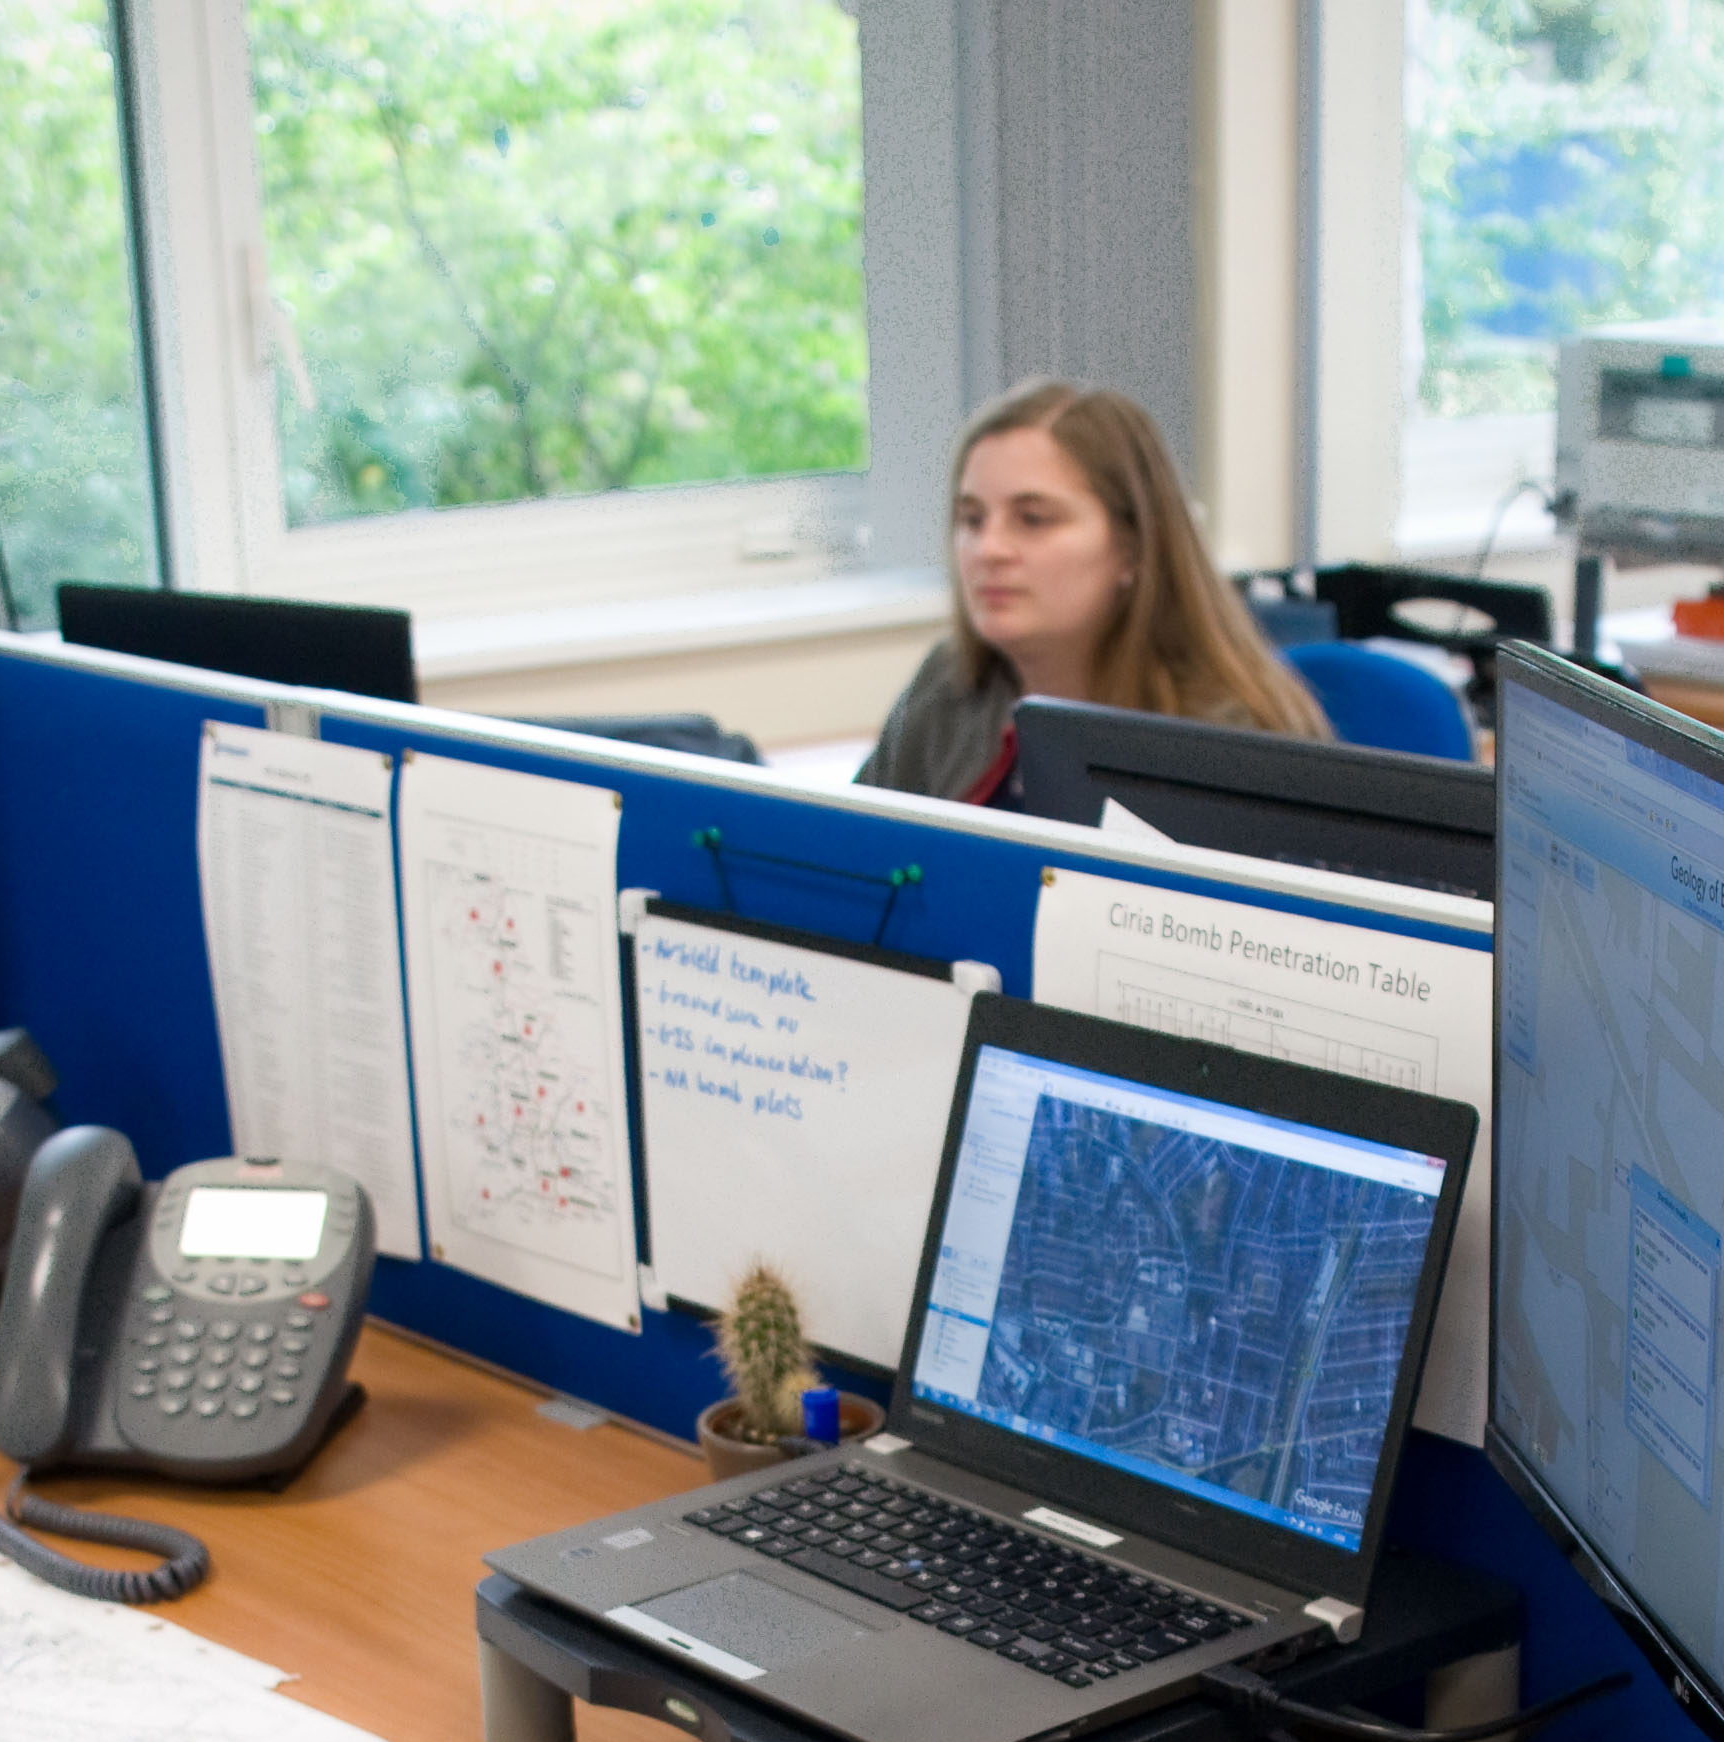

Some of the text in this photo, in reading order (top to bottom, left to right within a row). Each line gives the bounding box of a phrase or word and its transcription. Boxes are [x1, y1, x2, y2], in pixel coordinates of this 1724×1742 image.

[1671, 855, 1707, 902] Geology
[1709, 880, 1719, 904] of
[730, 952, 817, 1002] template
[1109, 903, 1432, 1002] Ciria Bomb Penetration Table
[696, 1072, 743, 1105] bomb
[753, 1088, 803, 1120] plots
[1295, 1489, 1363, 1524] Google Earth
